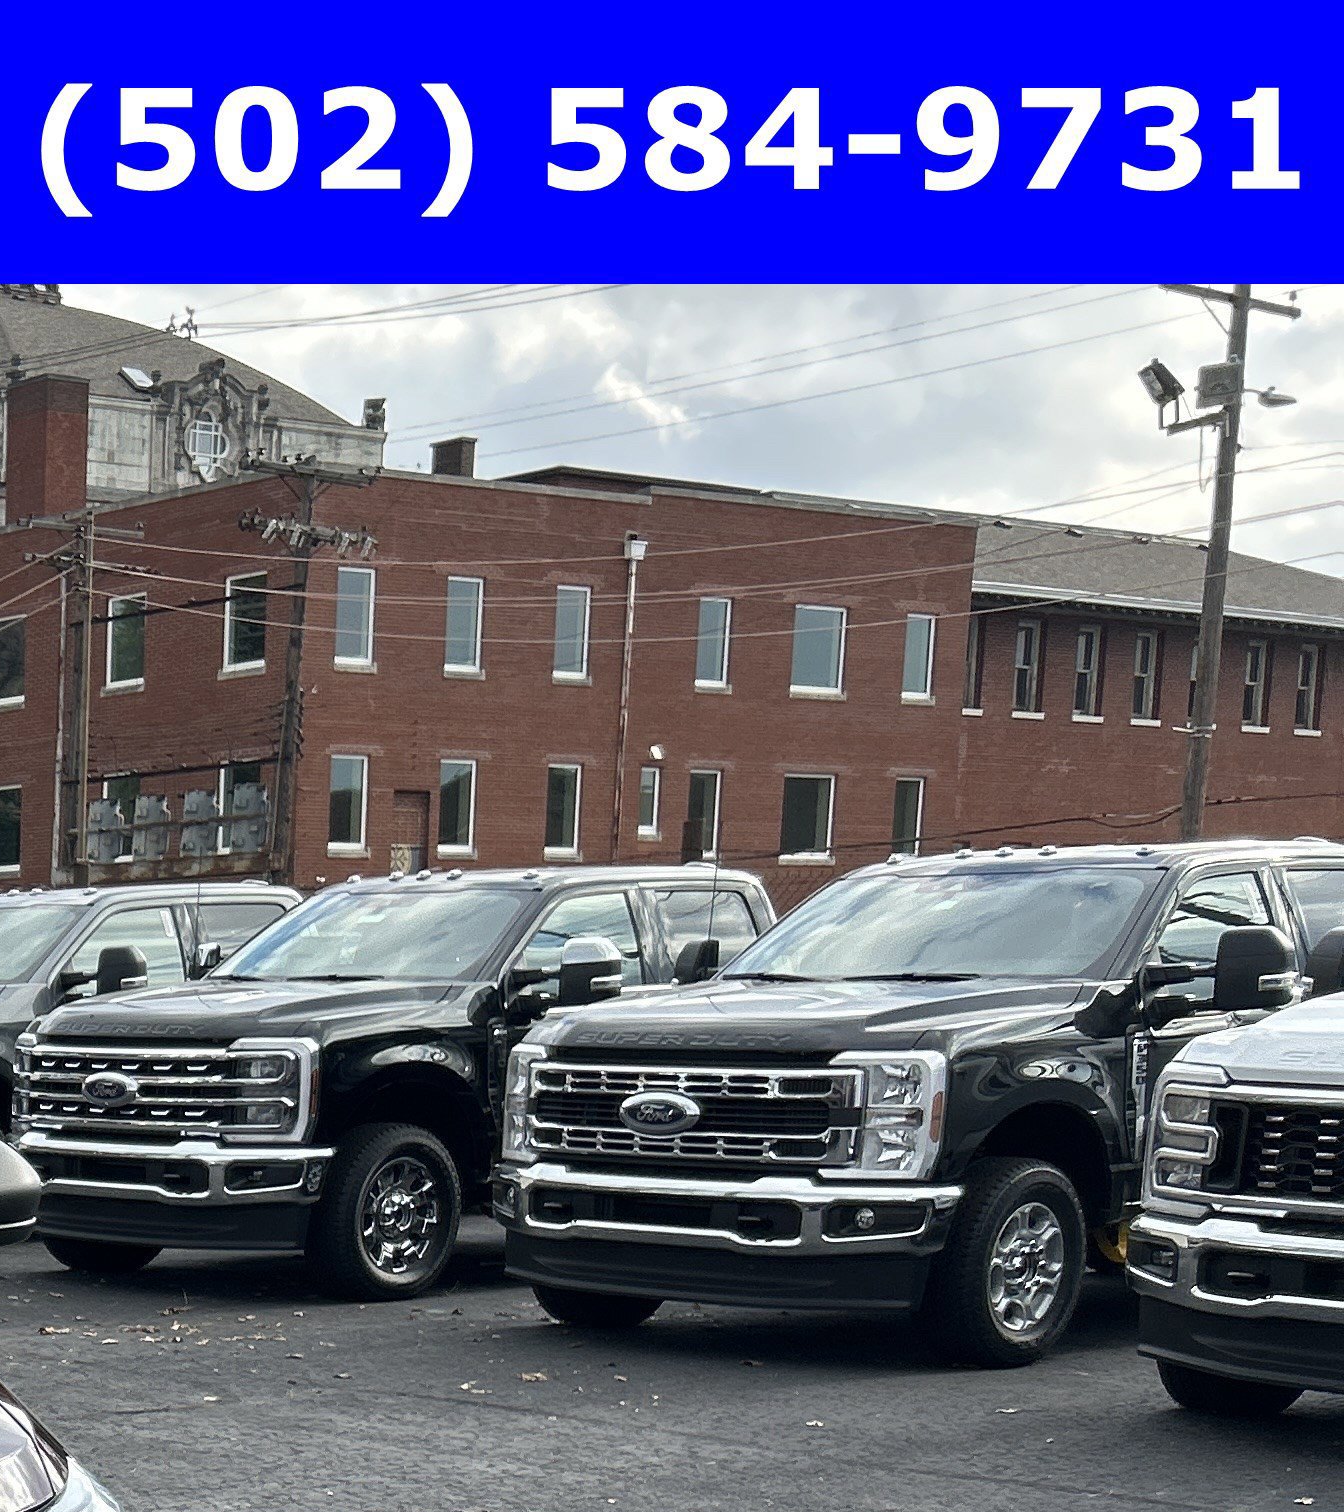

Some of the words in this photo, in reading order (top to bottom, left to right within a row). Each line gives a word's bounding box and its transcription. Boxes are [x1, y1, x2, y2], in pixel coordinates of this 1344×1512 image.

[575, 1030, 685, 1045] SUPER
[689, 1033, 792, 1047] DUTY
[635, 1103, 674, 1122] Ford
